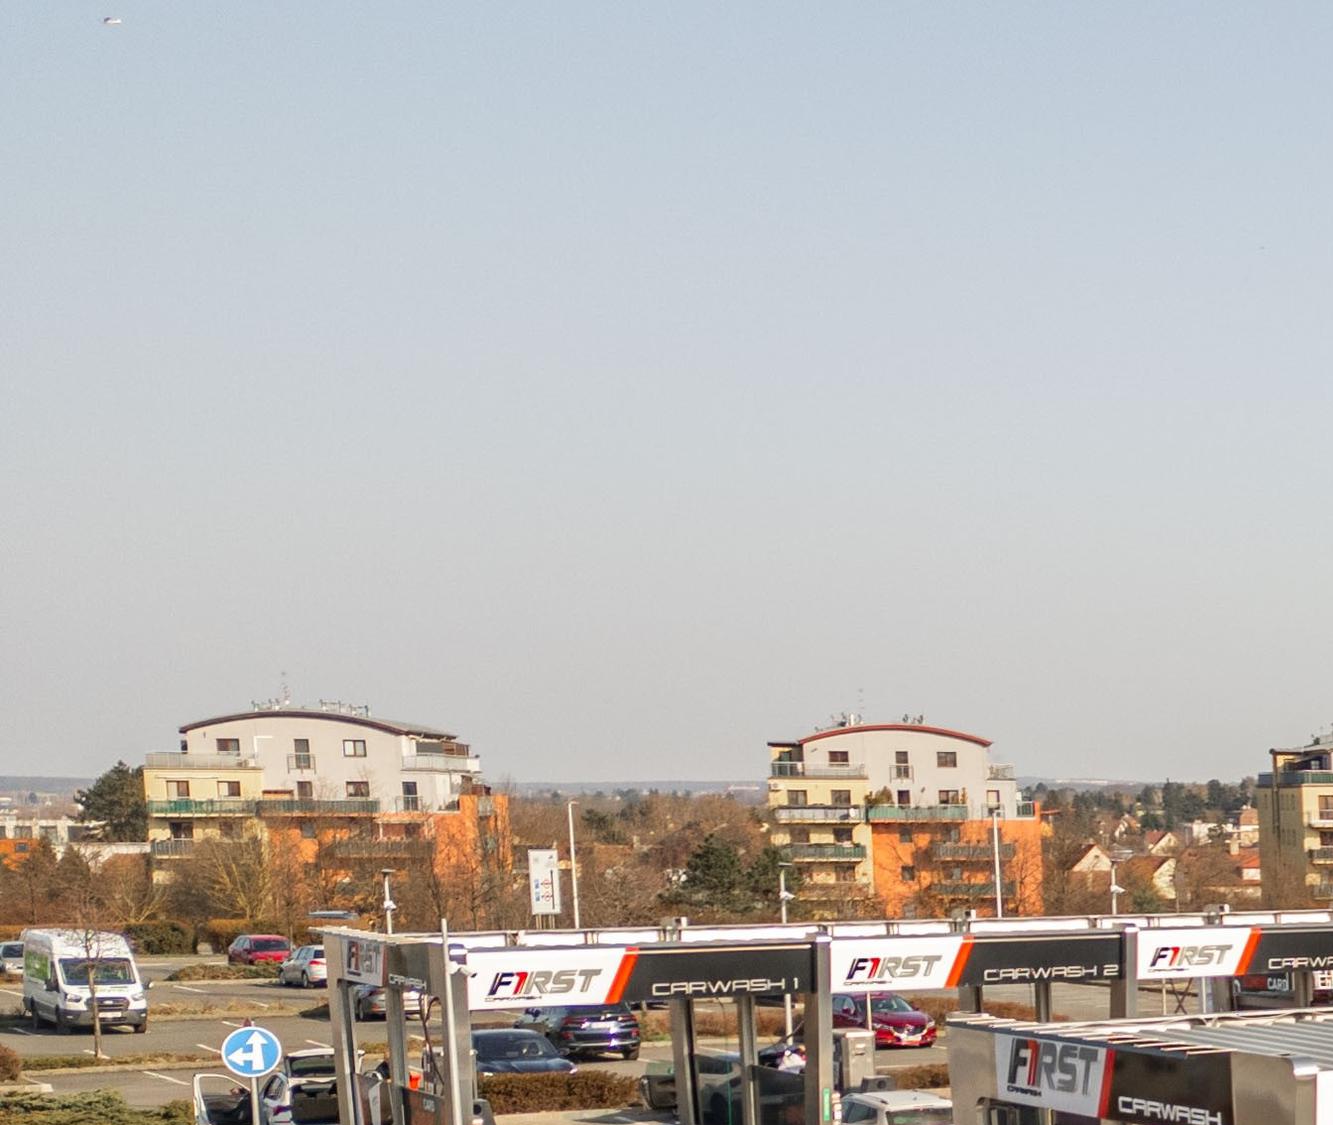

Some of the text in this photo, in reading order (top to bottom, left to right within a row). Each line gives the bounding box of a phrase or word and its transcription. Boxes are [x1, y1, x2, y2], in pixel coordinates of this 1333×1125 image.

[984, 964, 1119, 982] CARWASH 2
[652, 978, 799, 997] CARWASH 1
